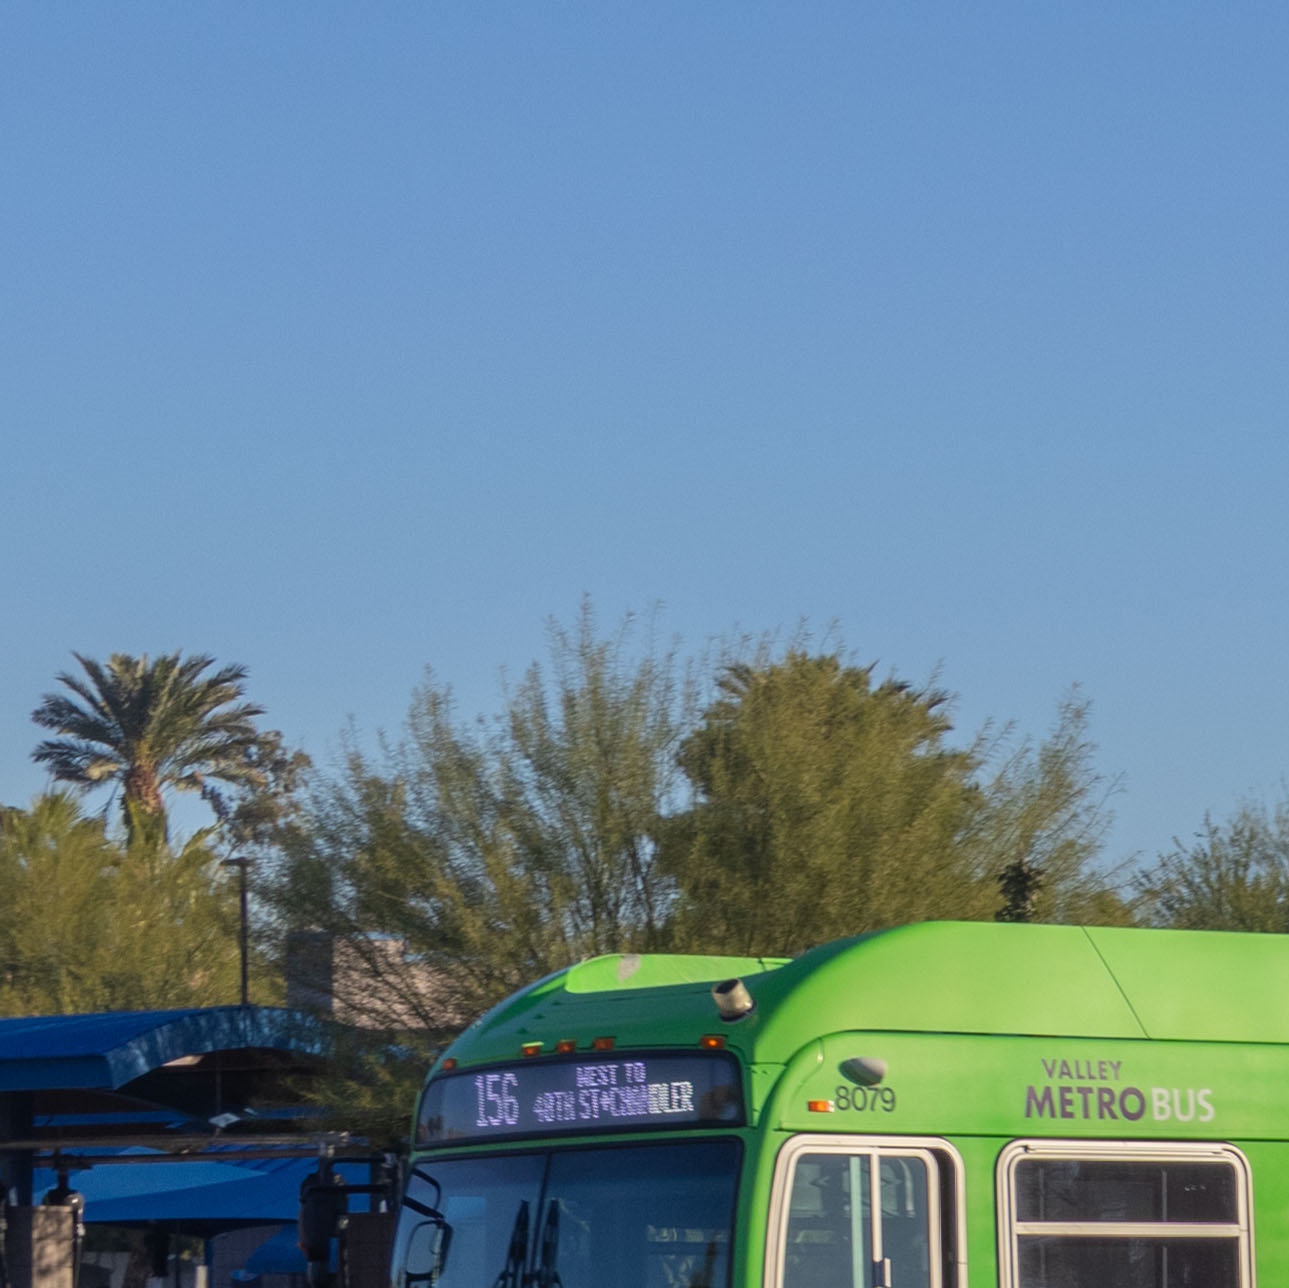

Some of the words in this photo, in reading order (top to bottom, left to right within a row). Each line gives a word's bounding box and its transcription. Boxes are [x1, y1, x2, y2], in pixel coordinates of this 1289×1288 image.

[576, 1064, 618, 1087] WEST
[623, 1062, 646, 1083] TO
[1041, 1058, 1122, 1081] VALLEY
[474, 1072, 519, 1127] 156
[532, 1091, 576, 1123] 40TH
[835, 1085, 896, 1112] 8079
[1025, 1085, 1146, 1121] METRO
[1152, 1087, 1215, 1123] BUS
